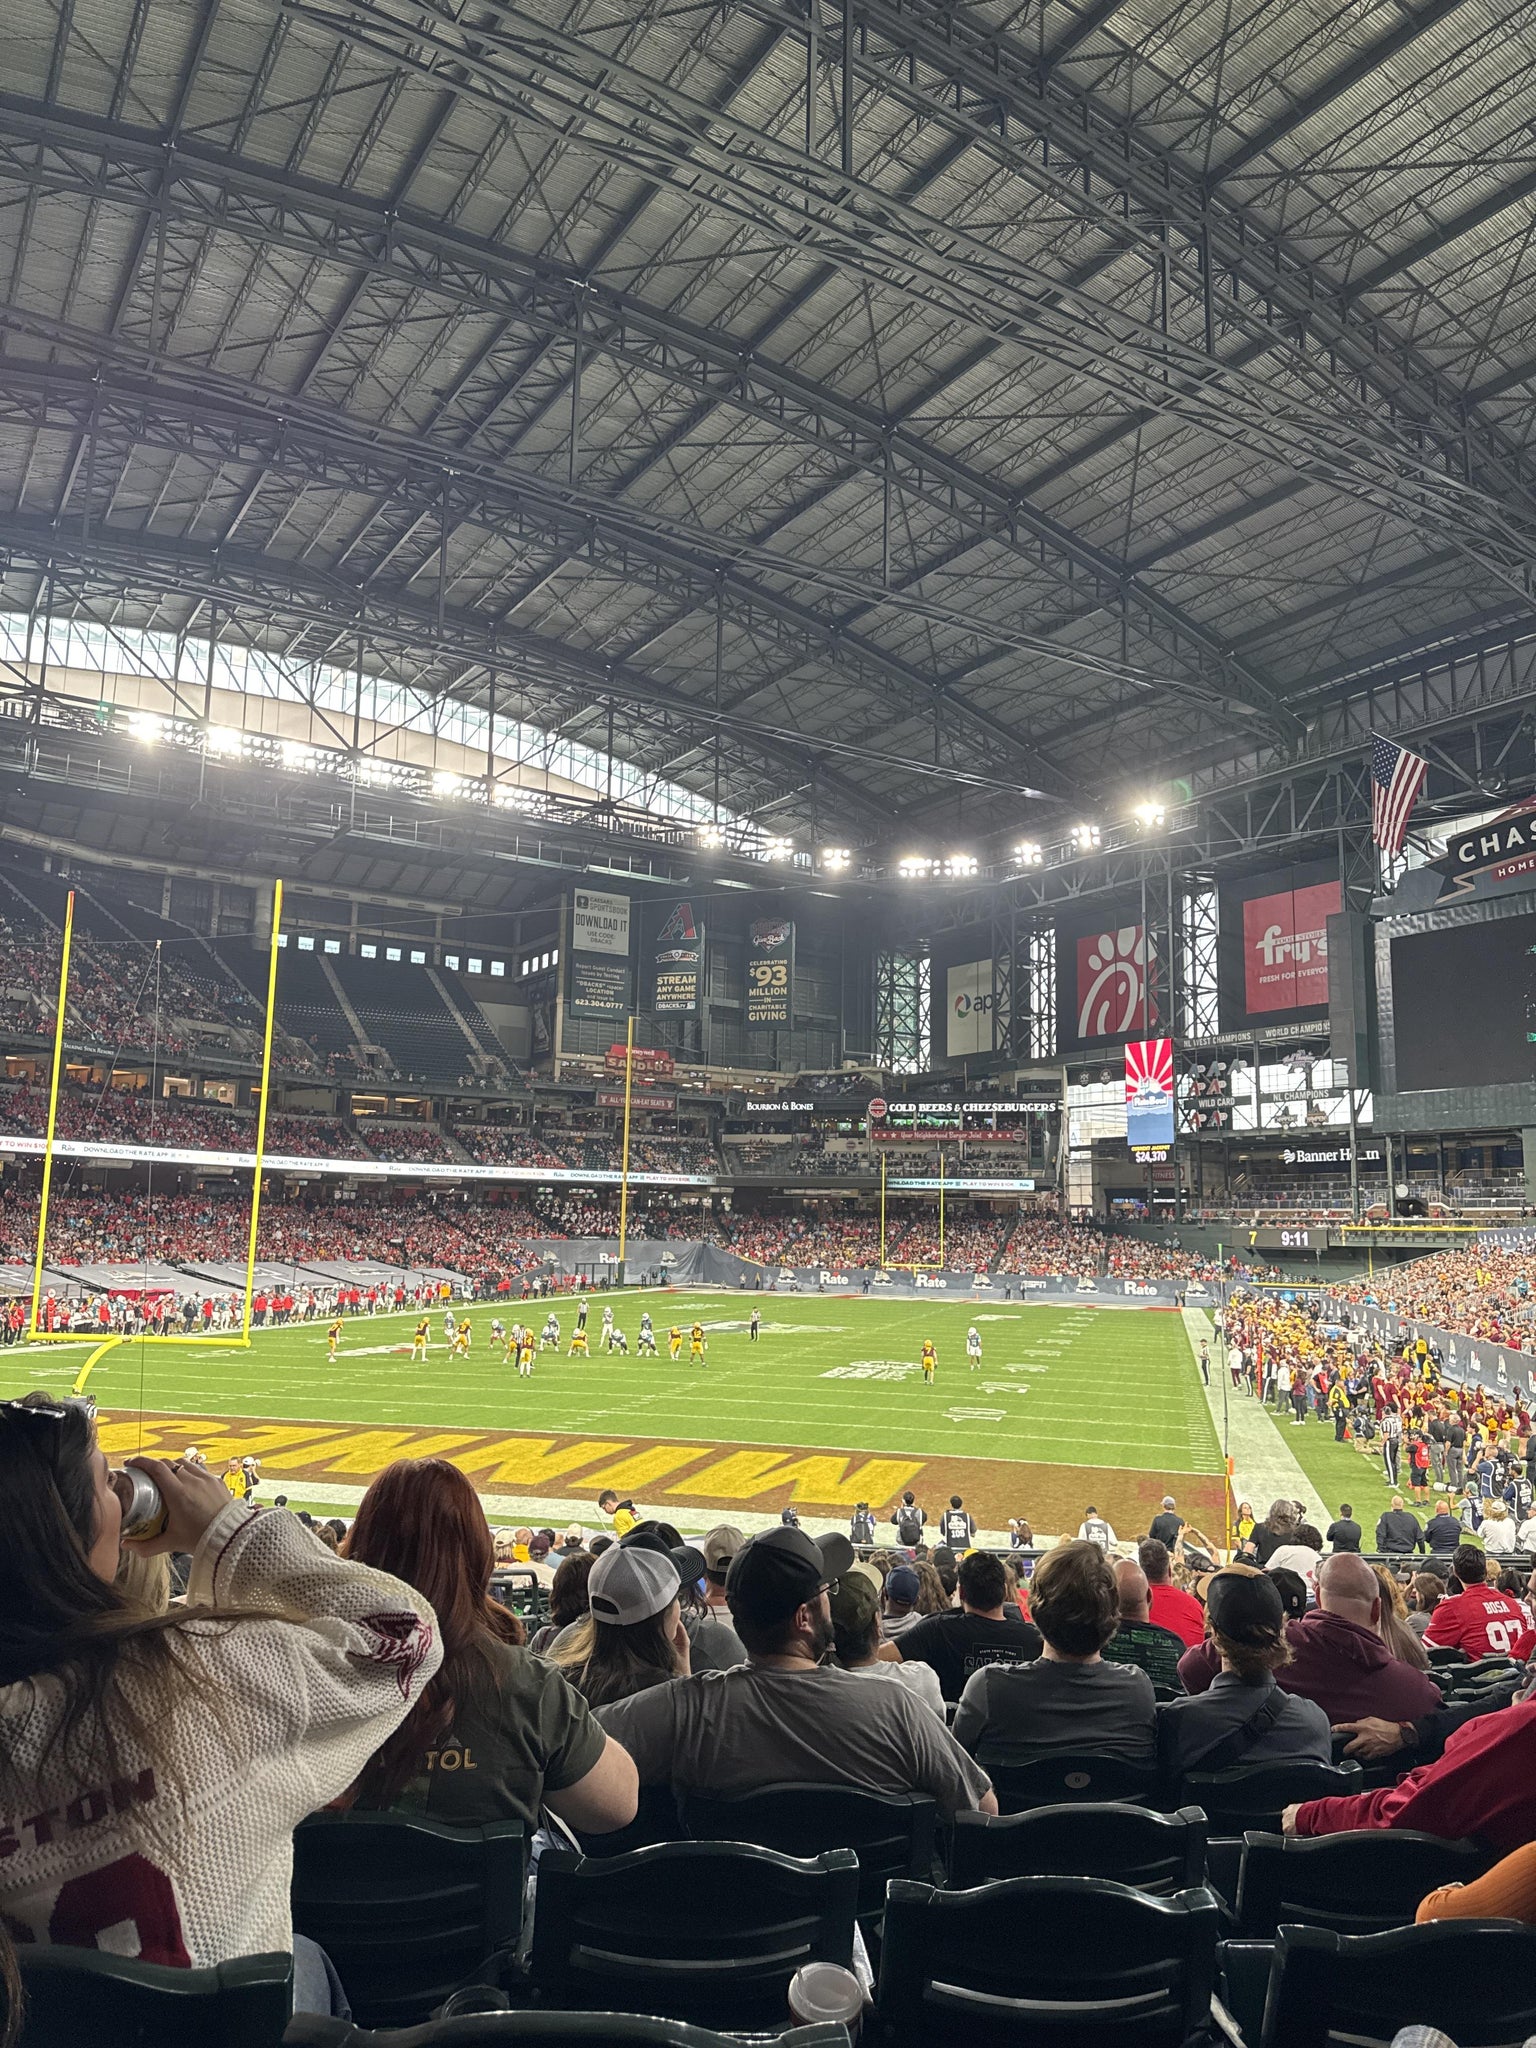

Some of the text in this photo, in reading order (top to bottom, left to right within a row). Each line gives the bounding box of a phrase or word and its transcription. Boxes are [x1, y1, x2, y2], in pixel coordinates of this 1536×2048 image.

[1498, 859, 1535, 877] HOME
[590, 902, 628, 915] SPORTSBOOK
[575, 913, 628, 932] DOWNLOAD IT
[749, 959, 788, 967] CELEBRATING
[656, 975, 697, 985] STREAM
[749, 965, 788, 987] $93
[1259, 965, 1328, 984] FRESH FOR EVERYON
[585, 987, 615, 996] LOCATION
[656, 985, 697, 993] ANY GAME
[748, 987, 788, 997] MILLION
[656, 993, 696, 1001] ANYWHERE
[574, 999, 624, 1010] 623.304.0777
[748, 1011, 788, 1021] GIVING
[1265, 1027, 1289, 1037] WORLD
[1193, 1037, 1211, 1046] WEST
[1212, 1032, 1251, 1044] CHAMPIONS
[608, 1058, 672, 1072] SANDLOT
[1273, 1089, 1330, 1101] NL CHAMPIONS
[650, 1099, 665, 1107] SEATS
[790, 1101, 814, 1110] BONES
[889, 1103, 917, 1112] COLD
[918, 1103, 953, 1112] BEERS
[962, 1103, 1056, 1112] CHEESEBURGERS
[1198, 1096, 1236, 1108] WILD CARD
[914, 1131, 948, 1139] Neighborhood
[949, 1132, 967, 1140] Burger
[83, 1146, 124, 1154] DOWNLOAD
[1296, 1148, 1339, 1163] Banner
[1135, 1150, 1167, 1163] $24,370
[1248, 1230, 1309, 1246] 7 9:11
[820, 1270, 849, 1285] Rate
[915, 1274, 947, 1288] Rate
[1124, 1281, 1158, 1295] Rate
[1482, 1601, 1510, 1615] BOSA
[1485, 1619, 1523, 1653] 97
